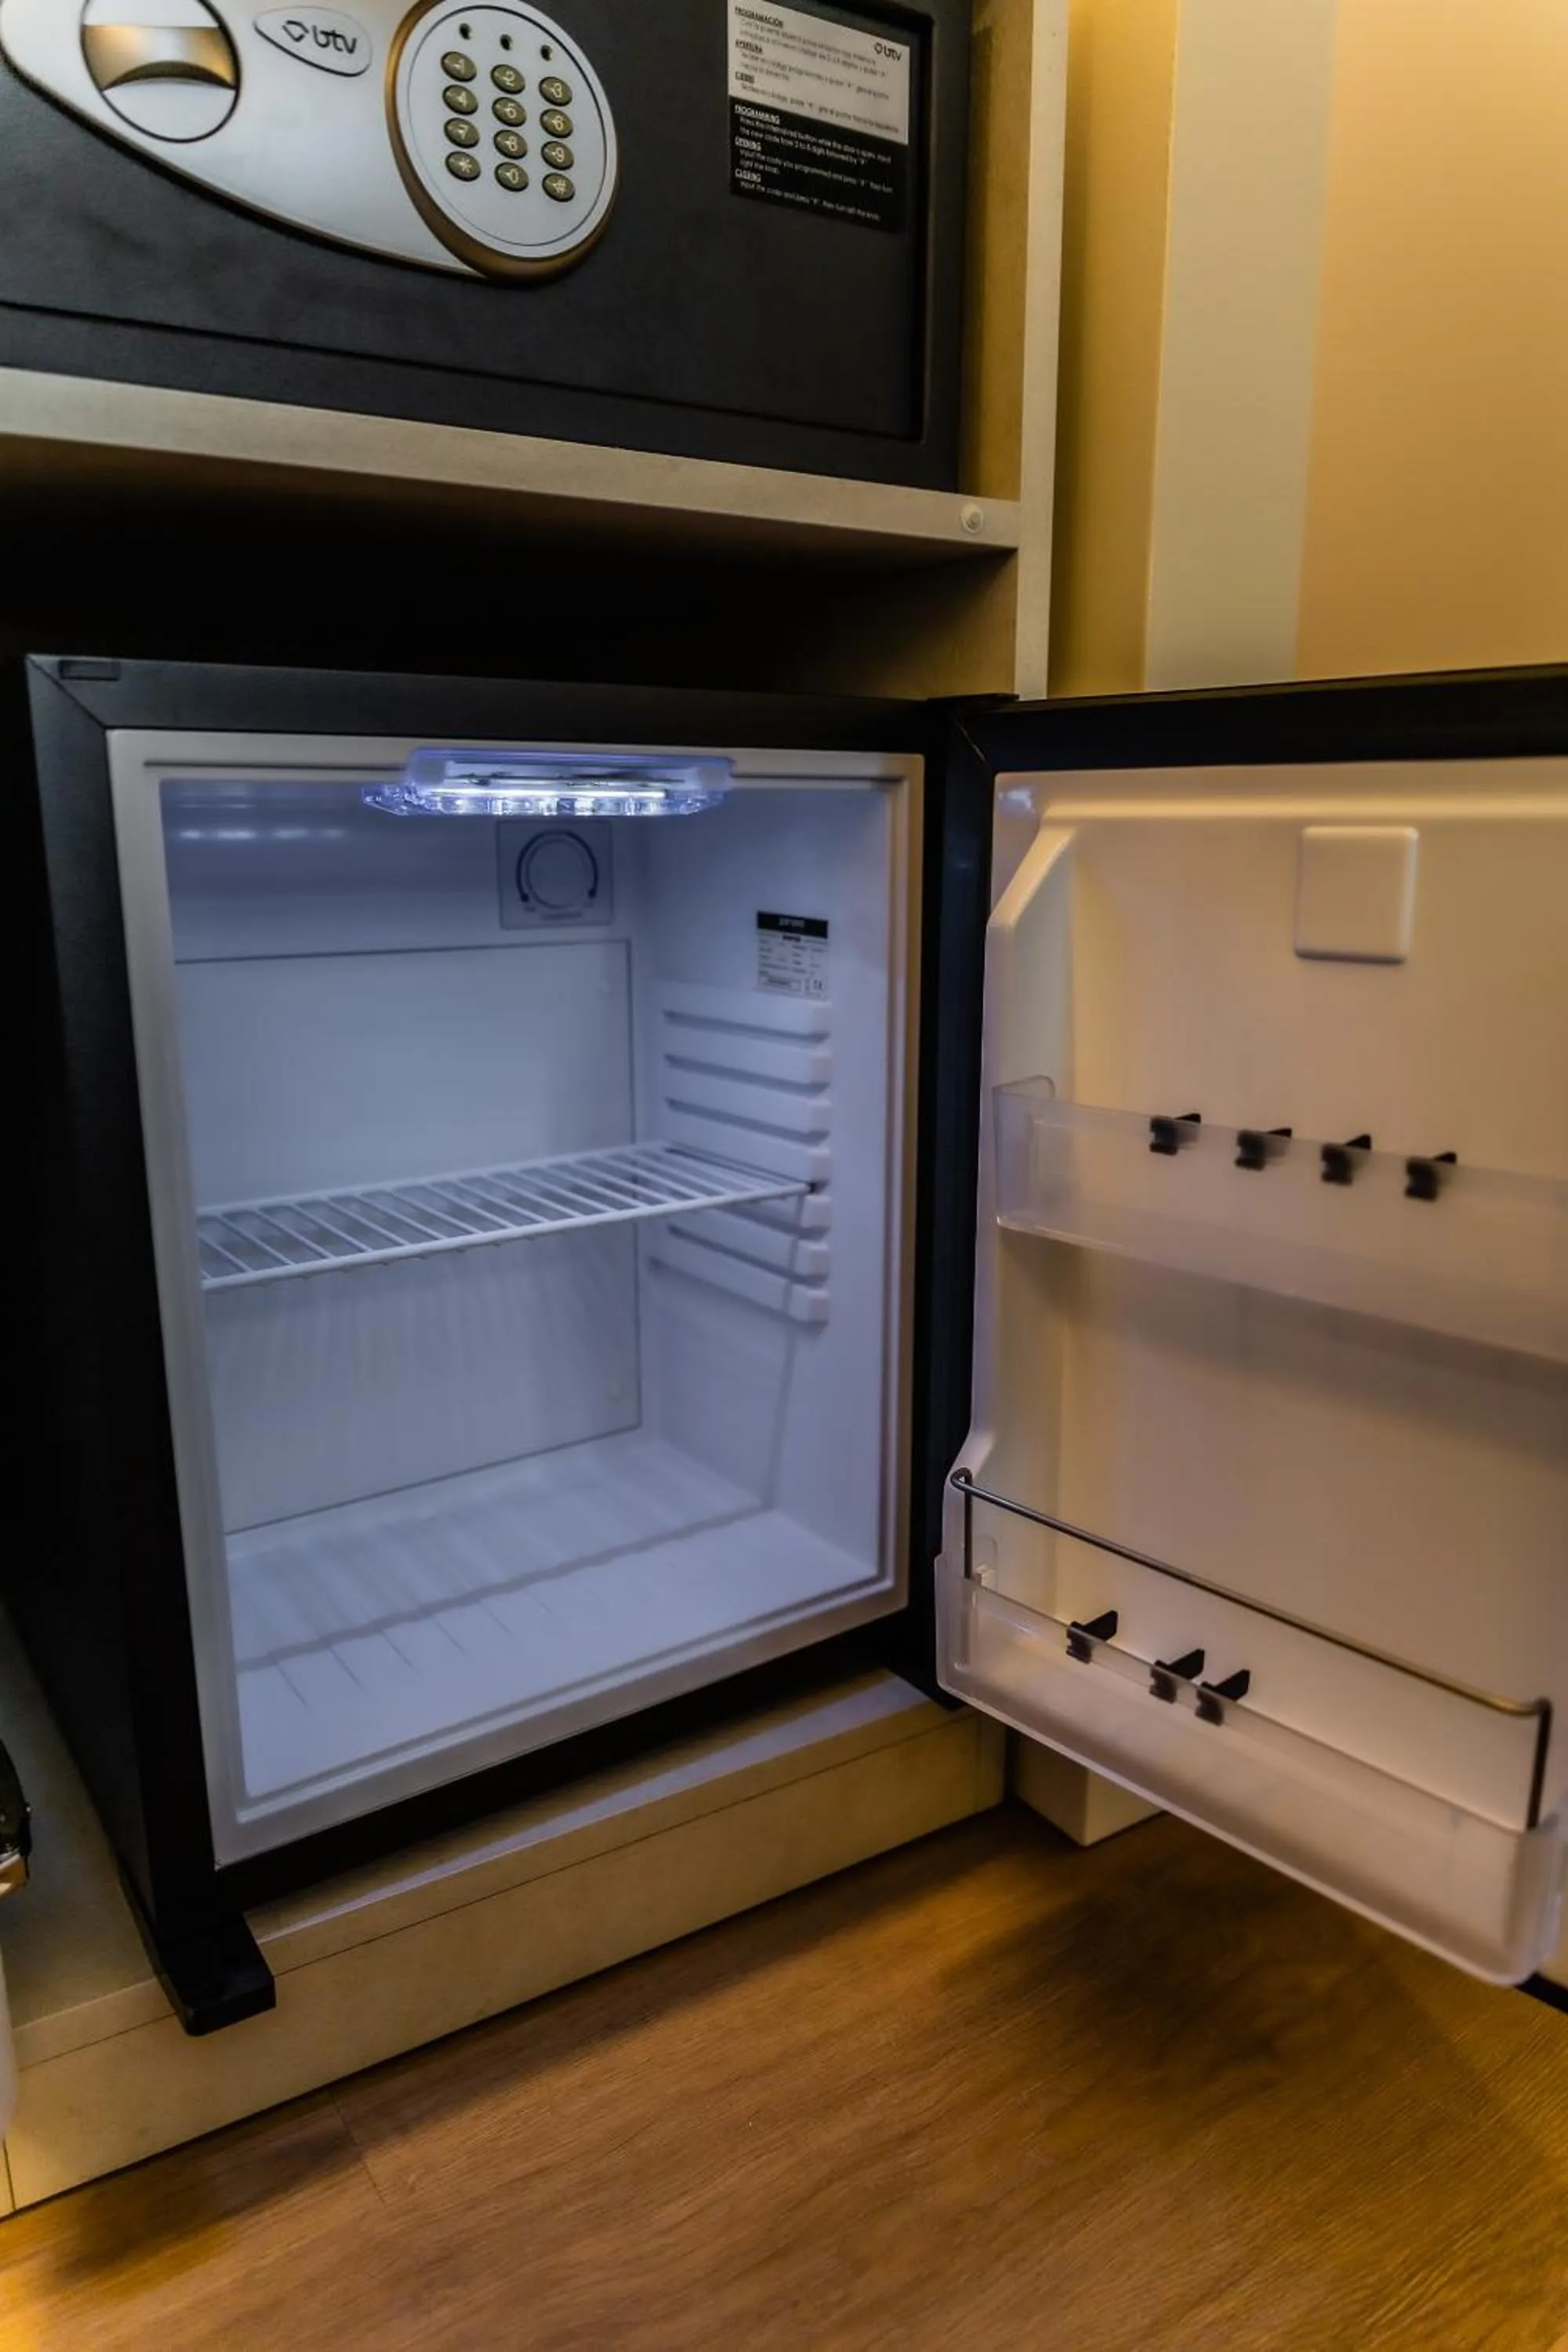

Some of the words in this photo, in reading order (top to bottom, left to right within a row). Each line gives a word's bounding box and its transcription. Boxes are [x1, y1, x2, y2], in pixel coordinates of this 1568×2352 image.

[312, 25, 358, 54] btv
[457, 59, 465, 74] 1
[505, 71, 514, 86] 2
[553, 82, 562, 98] 3
[457, 91, 467, 107] 4
[506, 103, 517, 118] 5
[554, 115, 564, 131] 6
[459, 124, 469, 140] 7
[509, 136, 517, 151] 8
[554, 147, 564, 162] 9
[509, 168, 519, 183] 0
[553, 179, 566, 195] #
